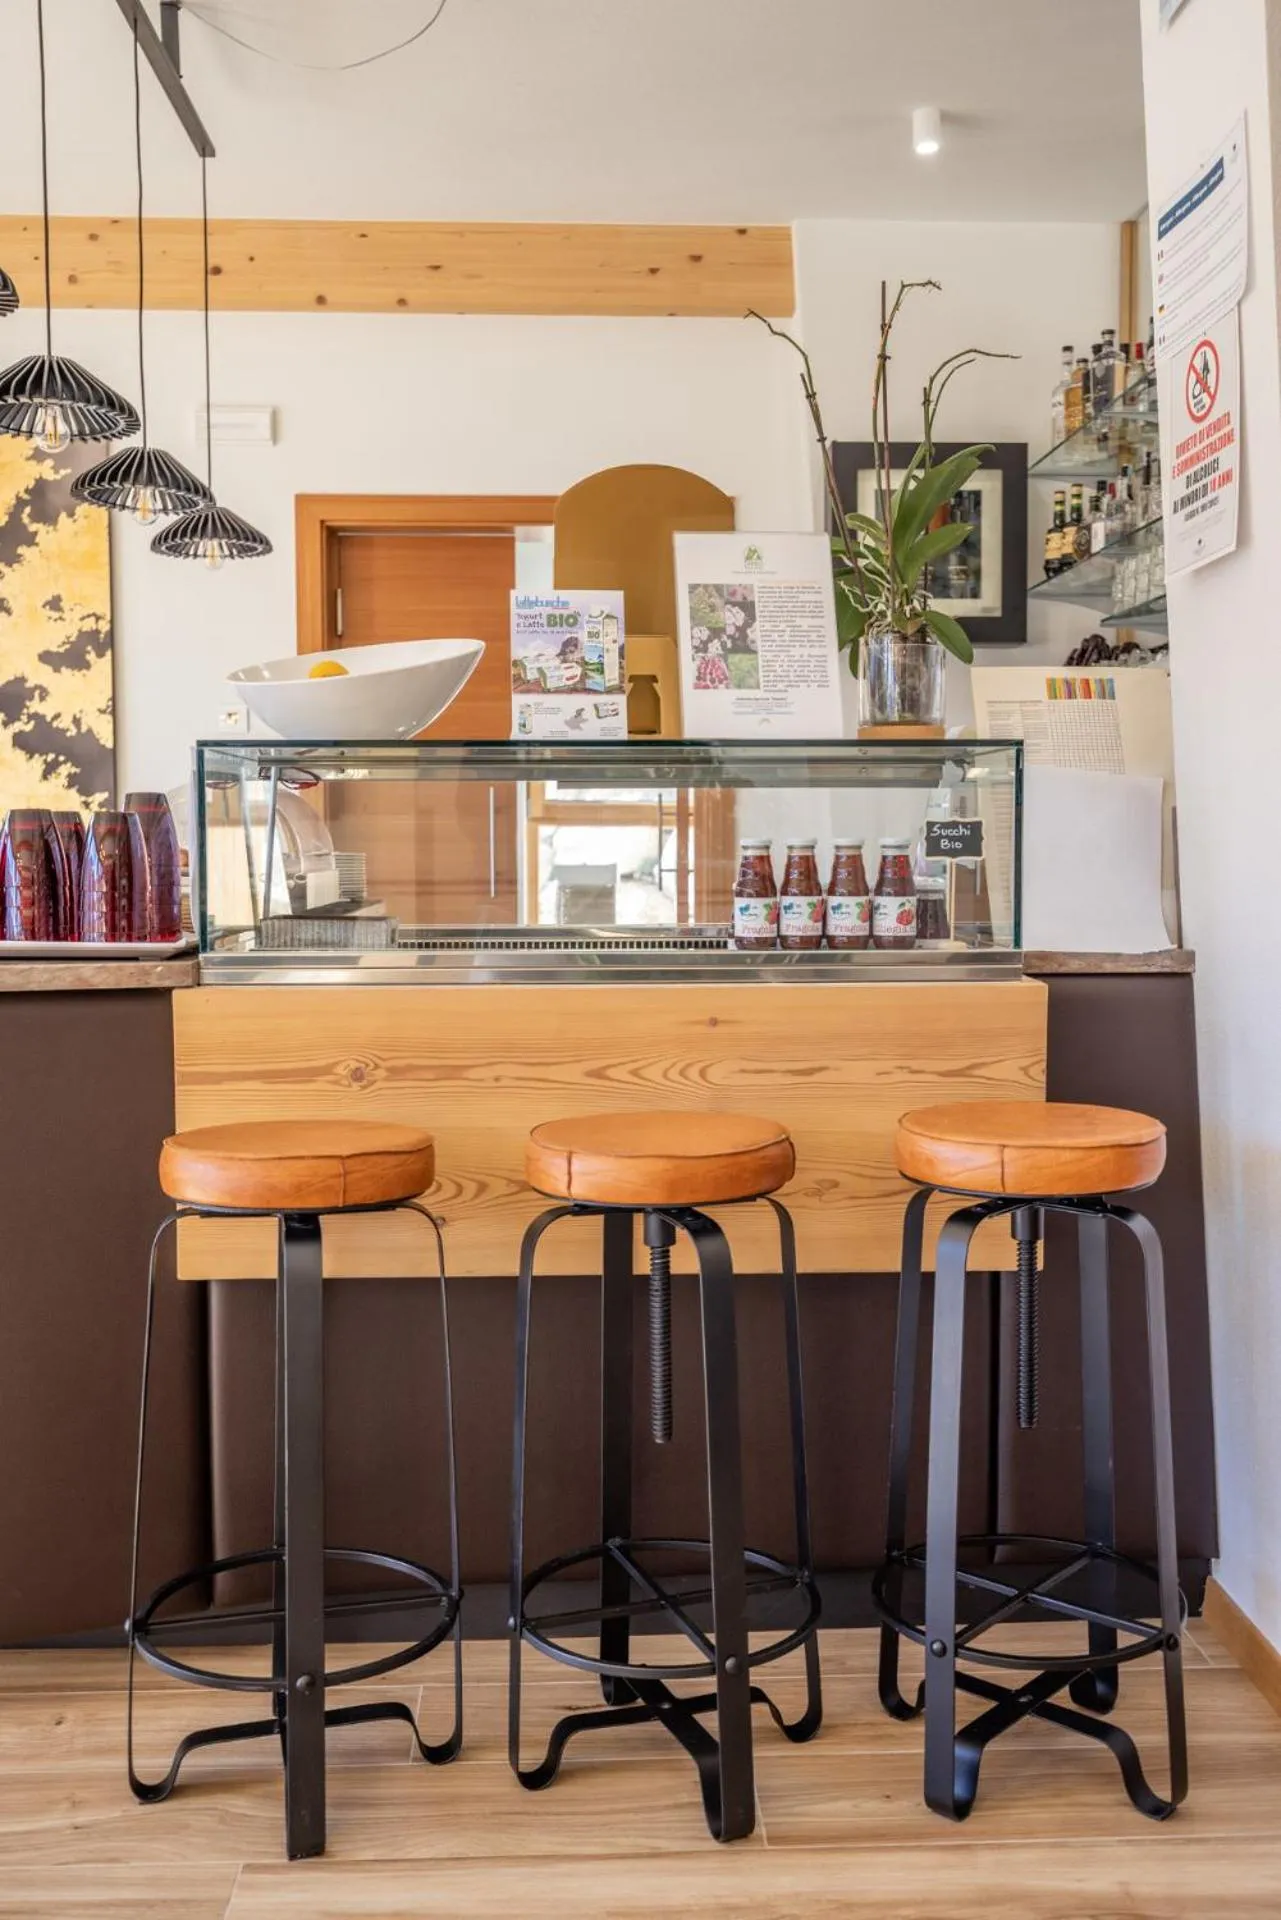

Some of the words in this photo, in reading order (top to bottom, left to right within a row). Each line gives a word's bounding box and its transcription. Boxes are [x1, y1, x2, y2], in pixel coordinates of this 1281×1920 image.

[546, 613, 578, 628] BIO
[930, 824, 971, 836] Succhi
[940, 838, 963, 849] Bio
